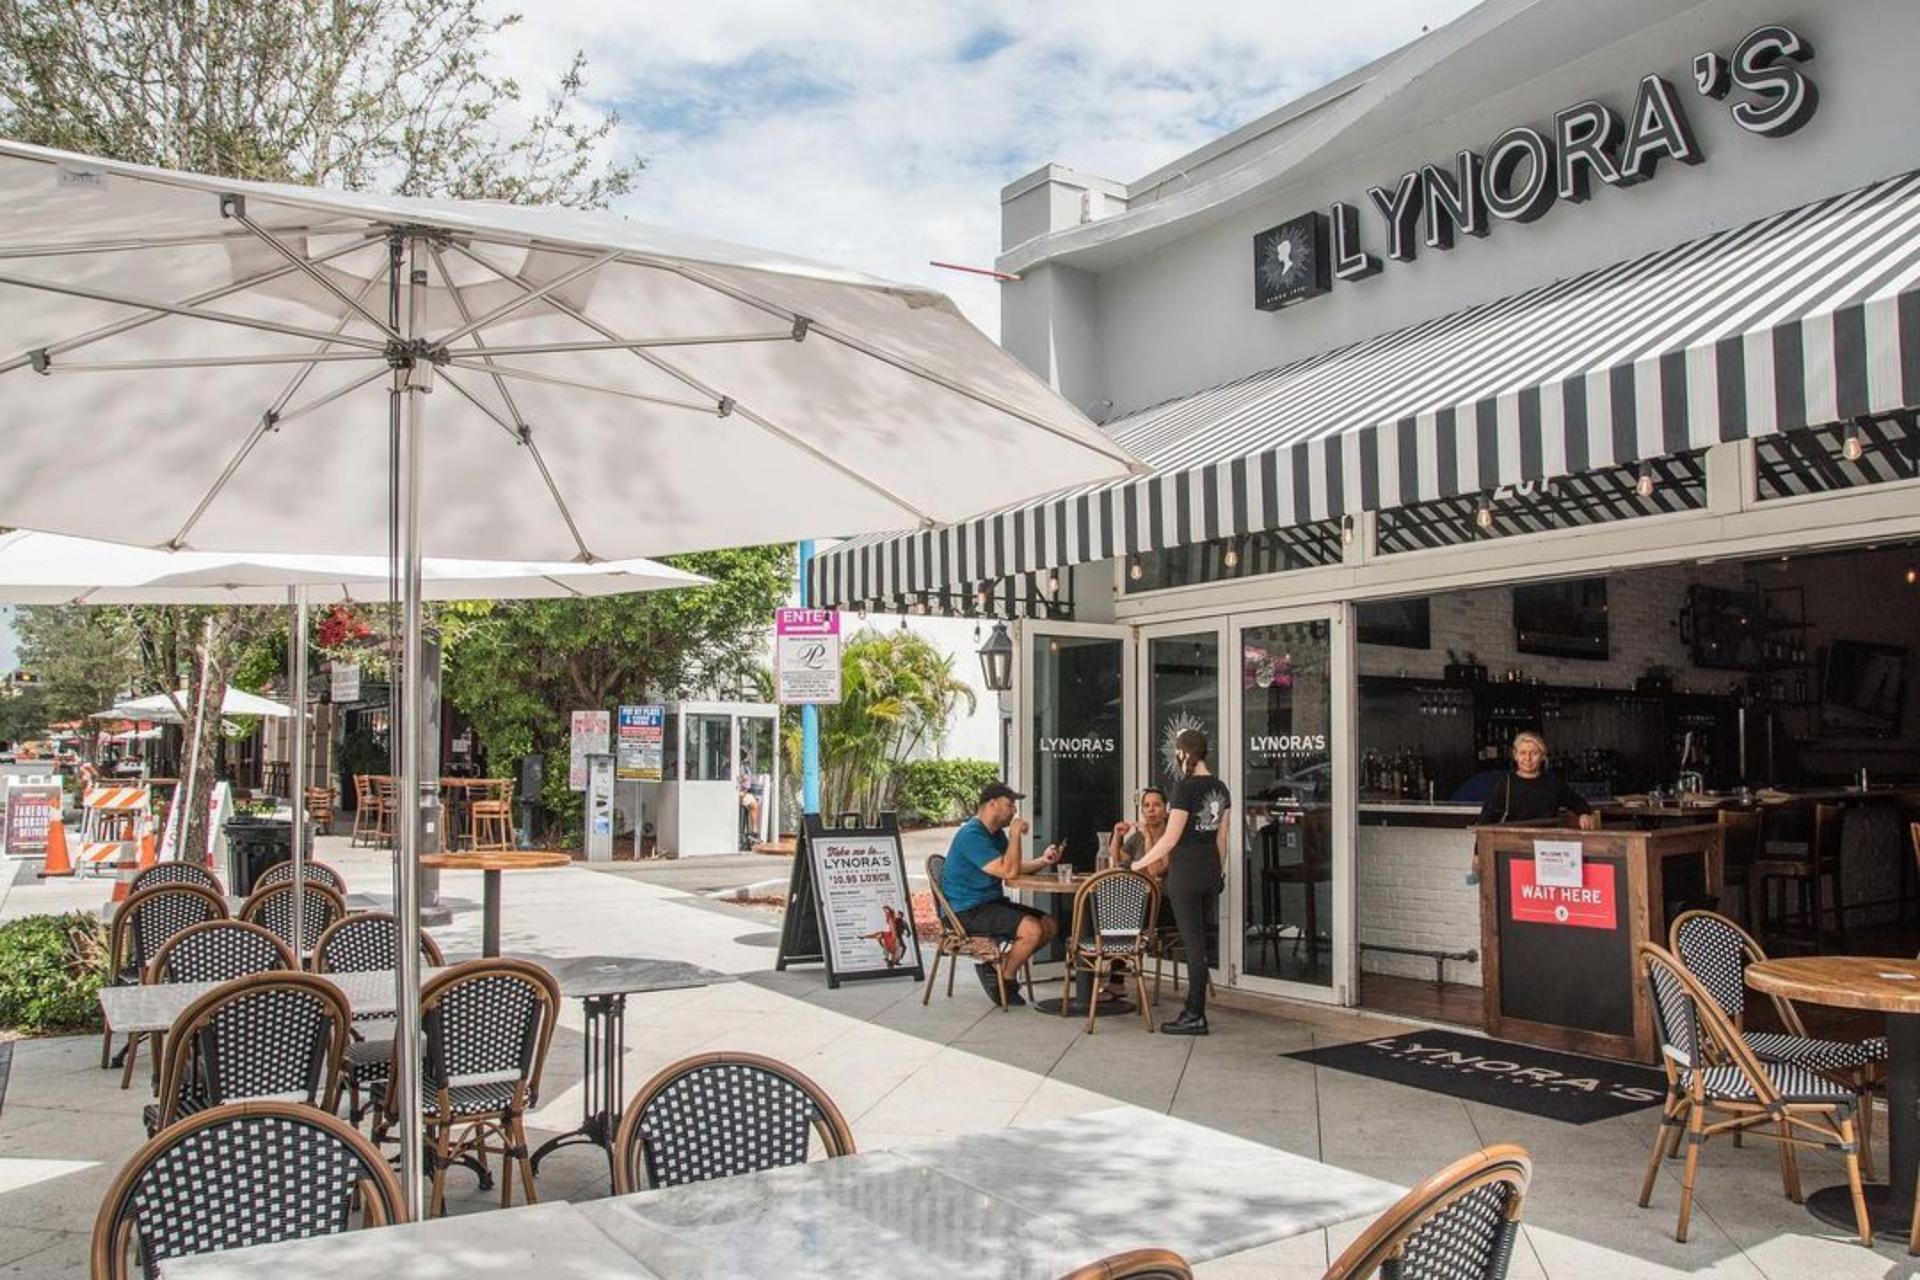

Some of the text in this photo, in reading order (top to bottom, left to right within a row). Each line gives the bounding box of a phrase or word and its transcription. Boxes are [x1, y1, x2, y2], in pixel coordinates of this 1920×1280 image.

[1333, 24, 1818, 281] LYNORA'S
[1040, 736, 1115, 752] LYNORA'S
[1251, 735, 1326, 751] LYNORA'S
[824, 856, 892, 869] LYNORA'S
[1521, 884, 1603, 904] WAIT HERE
[1367, 1038, 1665, 1101] LYNORA'S
